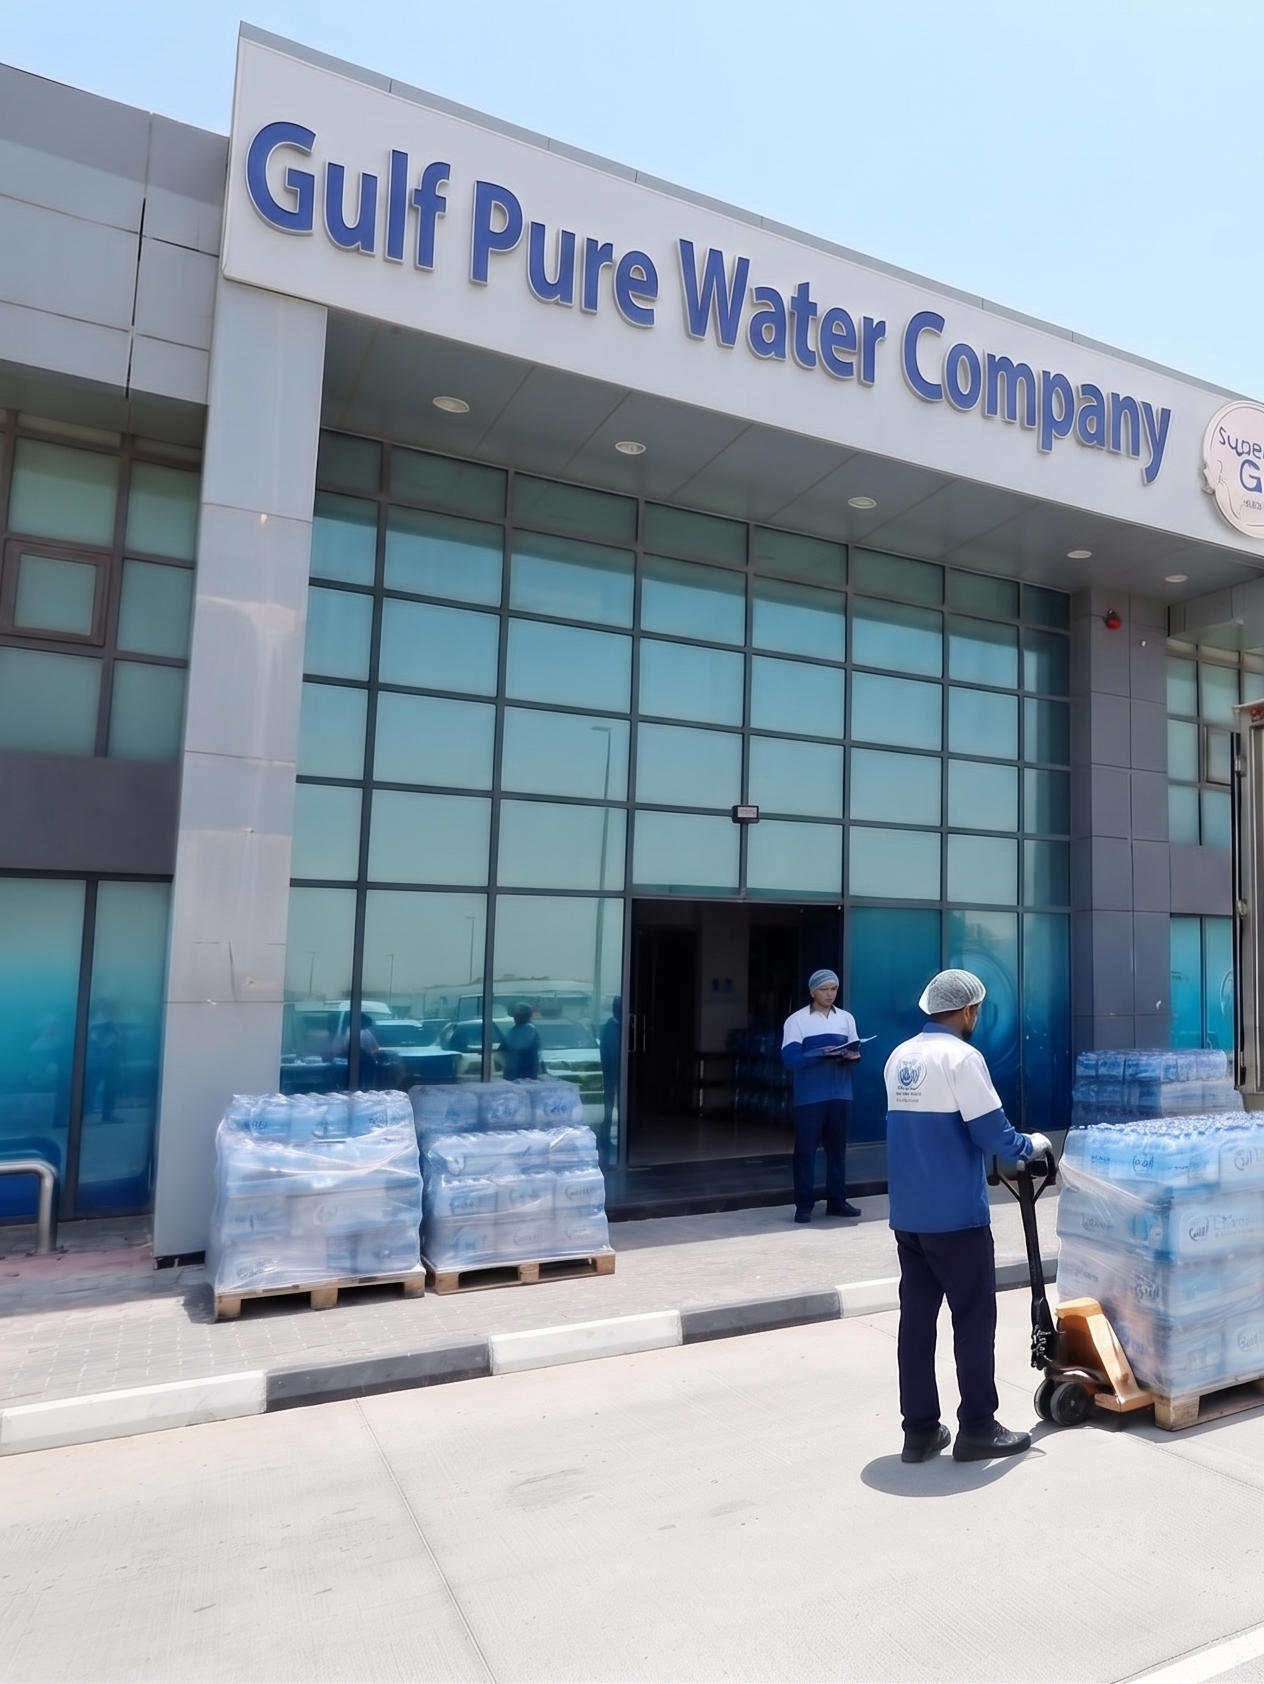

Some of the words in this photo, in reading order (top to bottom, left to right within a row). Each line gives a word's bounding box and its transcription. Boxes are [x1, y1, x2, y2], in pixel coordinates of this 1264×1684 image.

[245, 120, 451, 271] Gulf
[469, 179, 659, 328] Pure
[678, 237, 886, 387] Water
[902, 309, 1172, 486] Company
